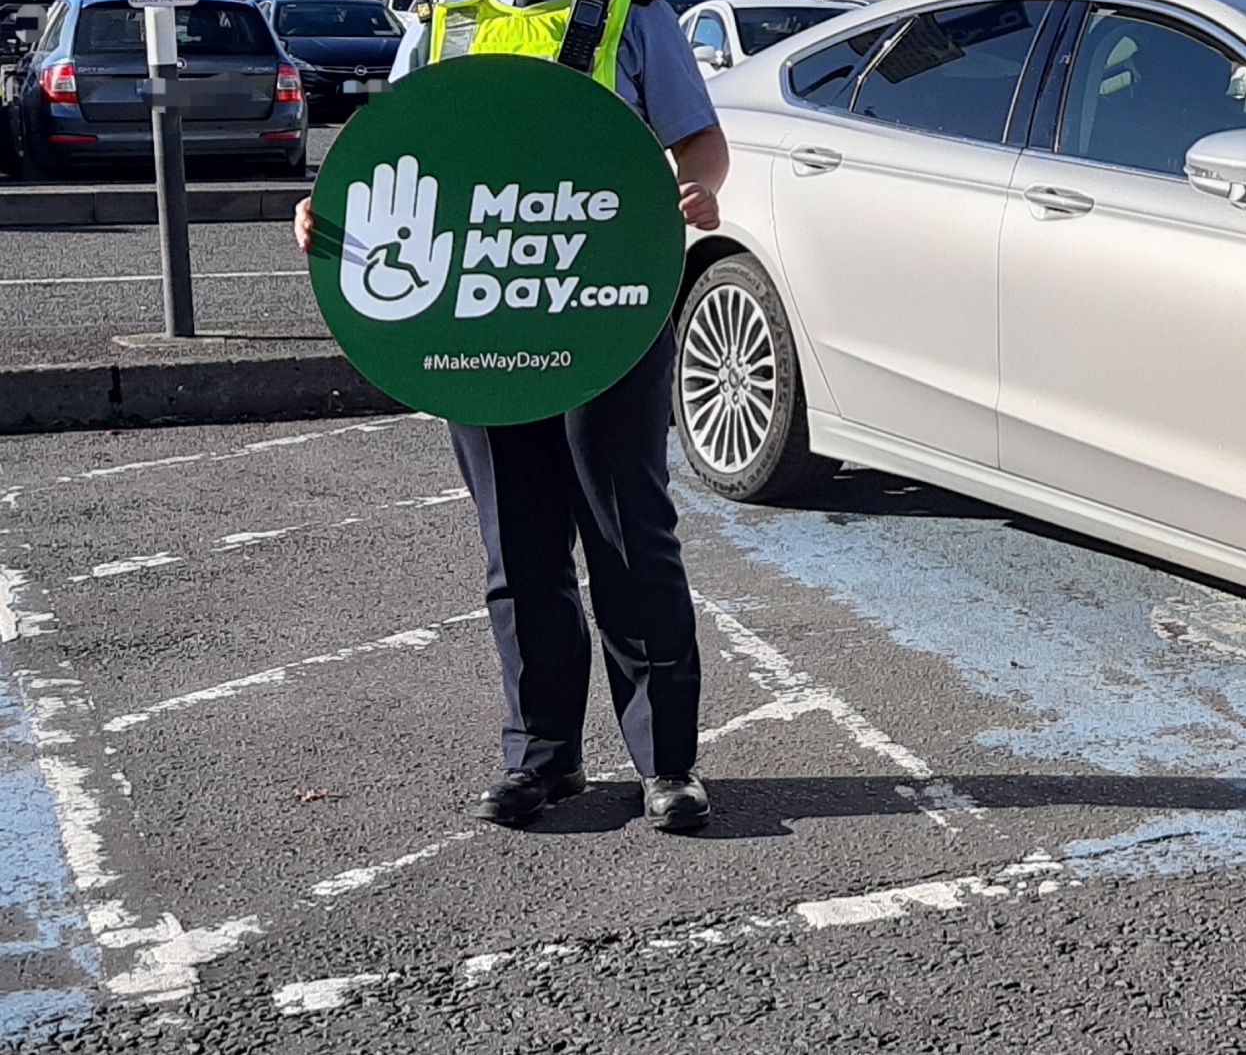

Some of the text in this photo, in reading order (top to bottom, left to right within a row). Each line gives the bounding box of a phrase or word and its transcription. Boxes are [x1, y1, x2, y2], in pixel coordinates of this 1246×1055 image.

[469, 181, 620, 224] Make
[462, 229, 587, 271] Way
[454, 273, 649, 319] Day.com
[423, 351, 572, 372] #MakeWayDay20
